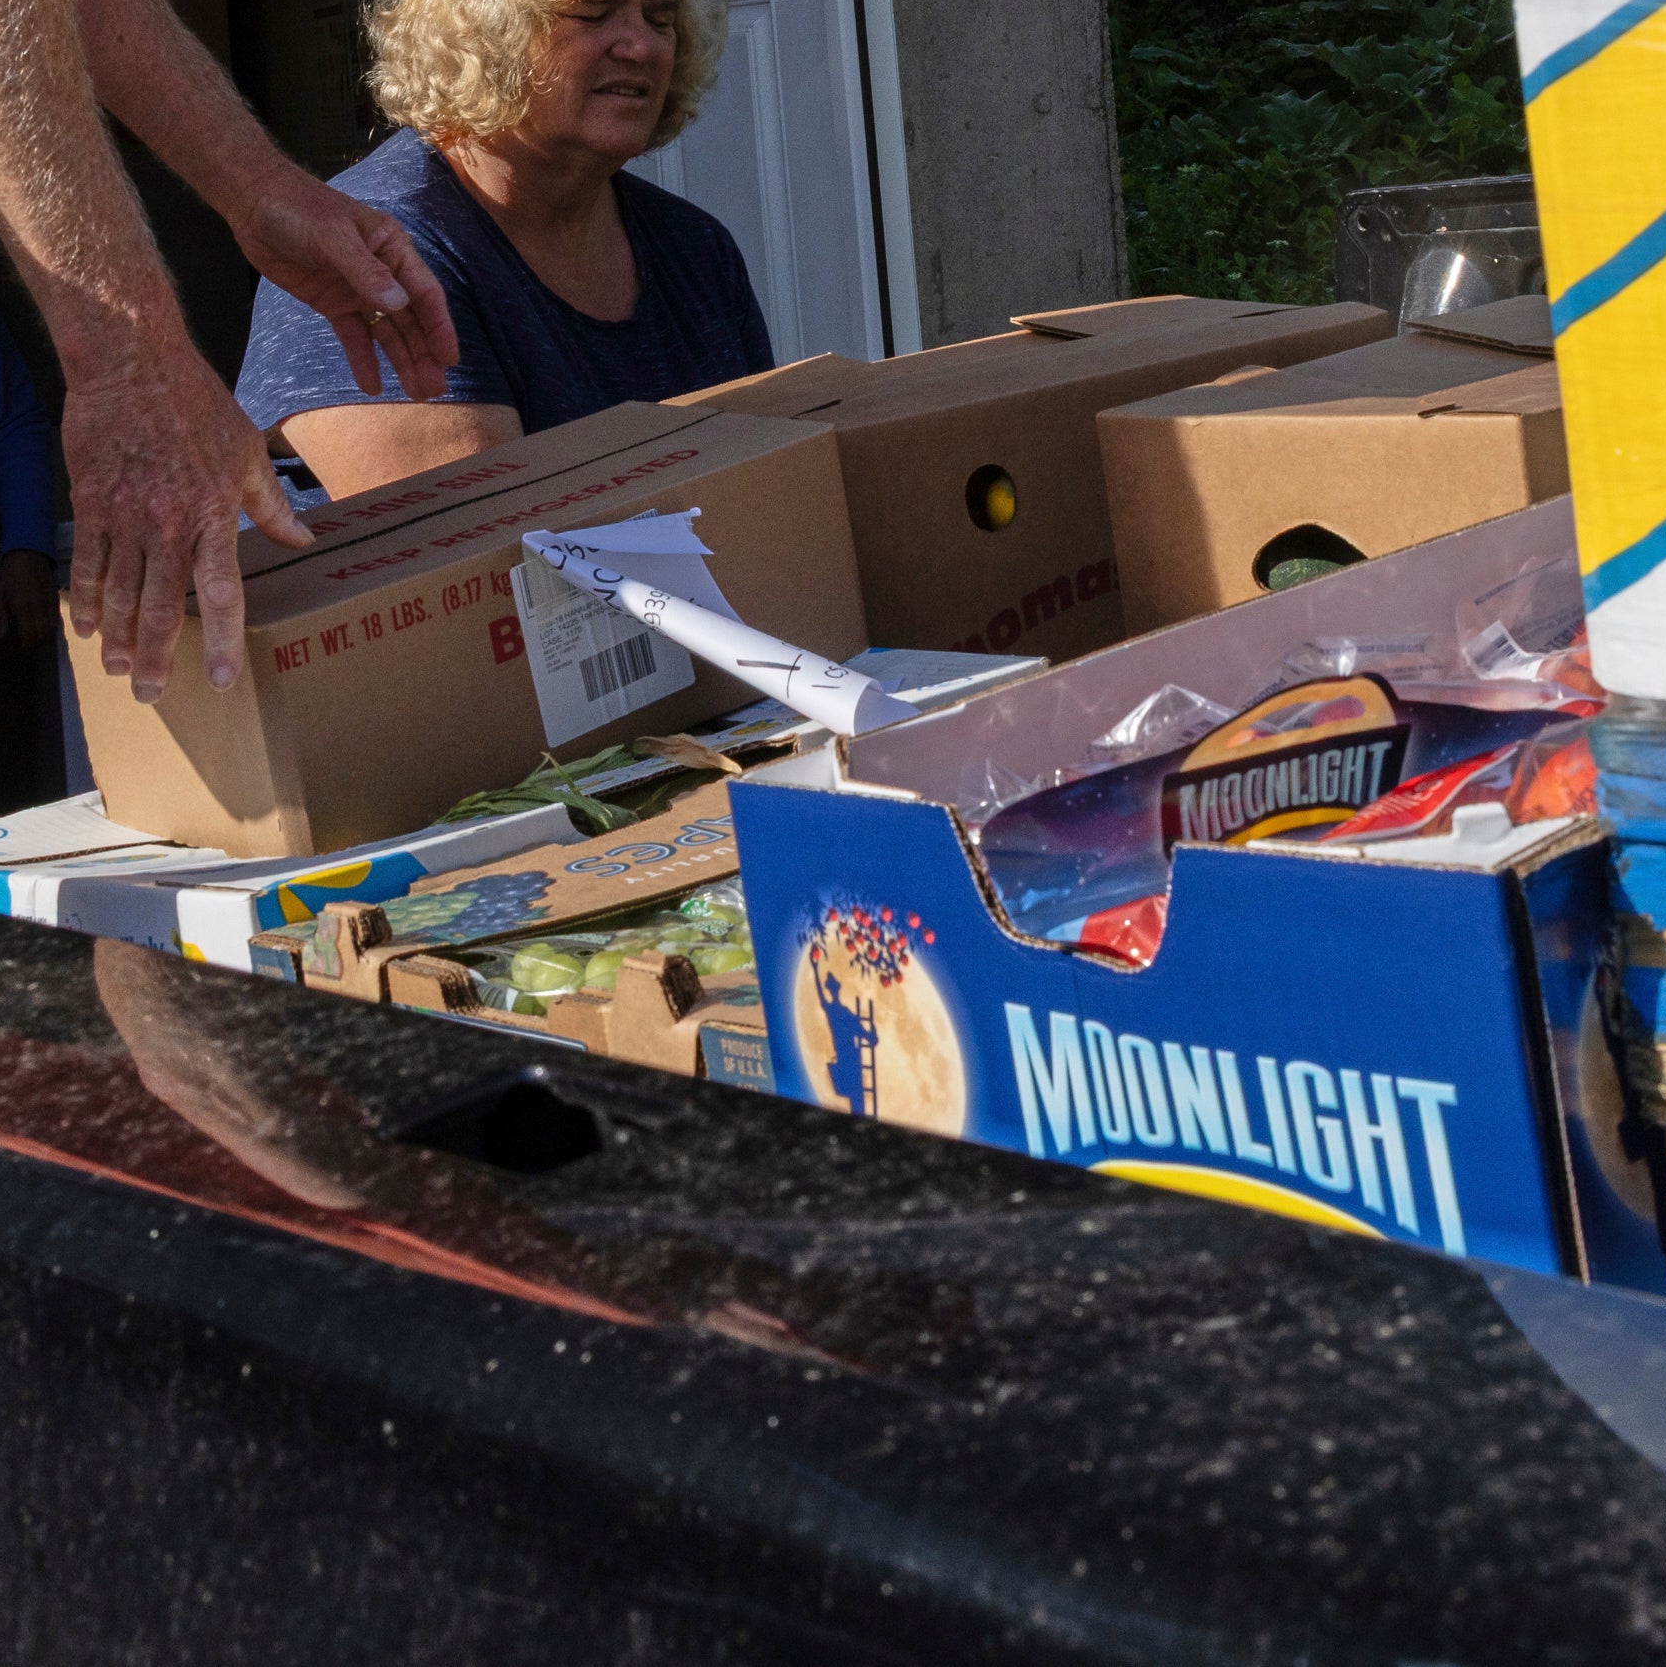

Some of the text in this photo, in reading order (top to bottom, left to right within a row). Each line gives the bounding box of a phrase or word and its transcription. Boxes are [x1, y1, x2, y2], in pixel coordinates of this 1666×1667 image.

[325, 447, 702, 583] KEEP REFRIGERATED
[351, 487, 436, 524] SIDE
[437, 459, 531, 496] THIS
[273, 636, 313, 674] NET
[320, 623, 355, 658] WT.
[360, 610, 384, 640] 18
[390, 597, 434, 632] LBS.
[441, 575, 483, 617] (8.17
[490, 567, 517, 604] kg
[1178, 739, 1394, 842] MOONLIGHT
[624, 841, 737, 885] UALITY
[1004, 1001, 1465, 1256] MOONLIGHT
